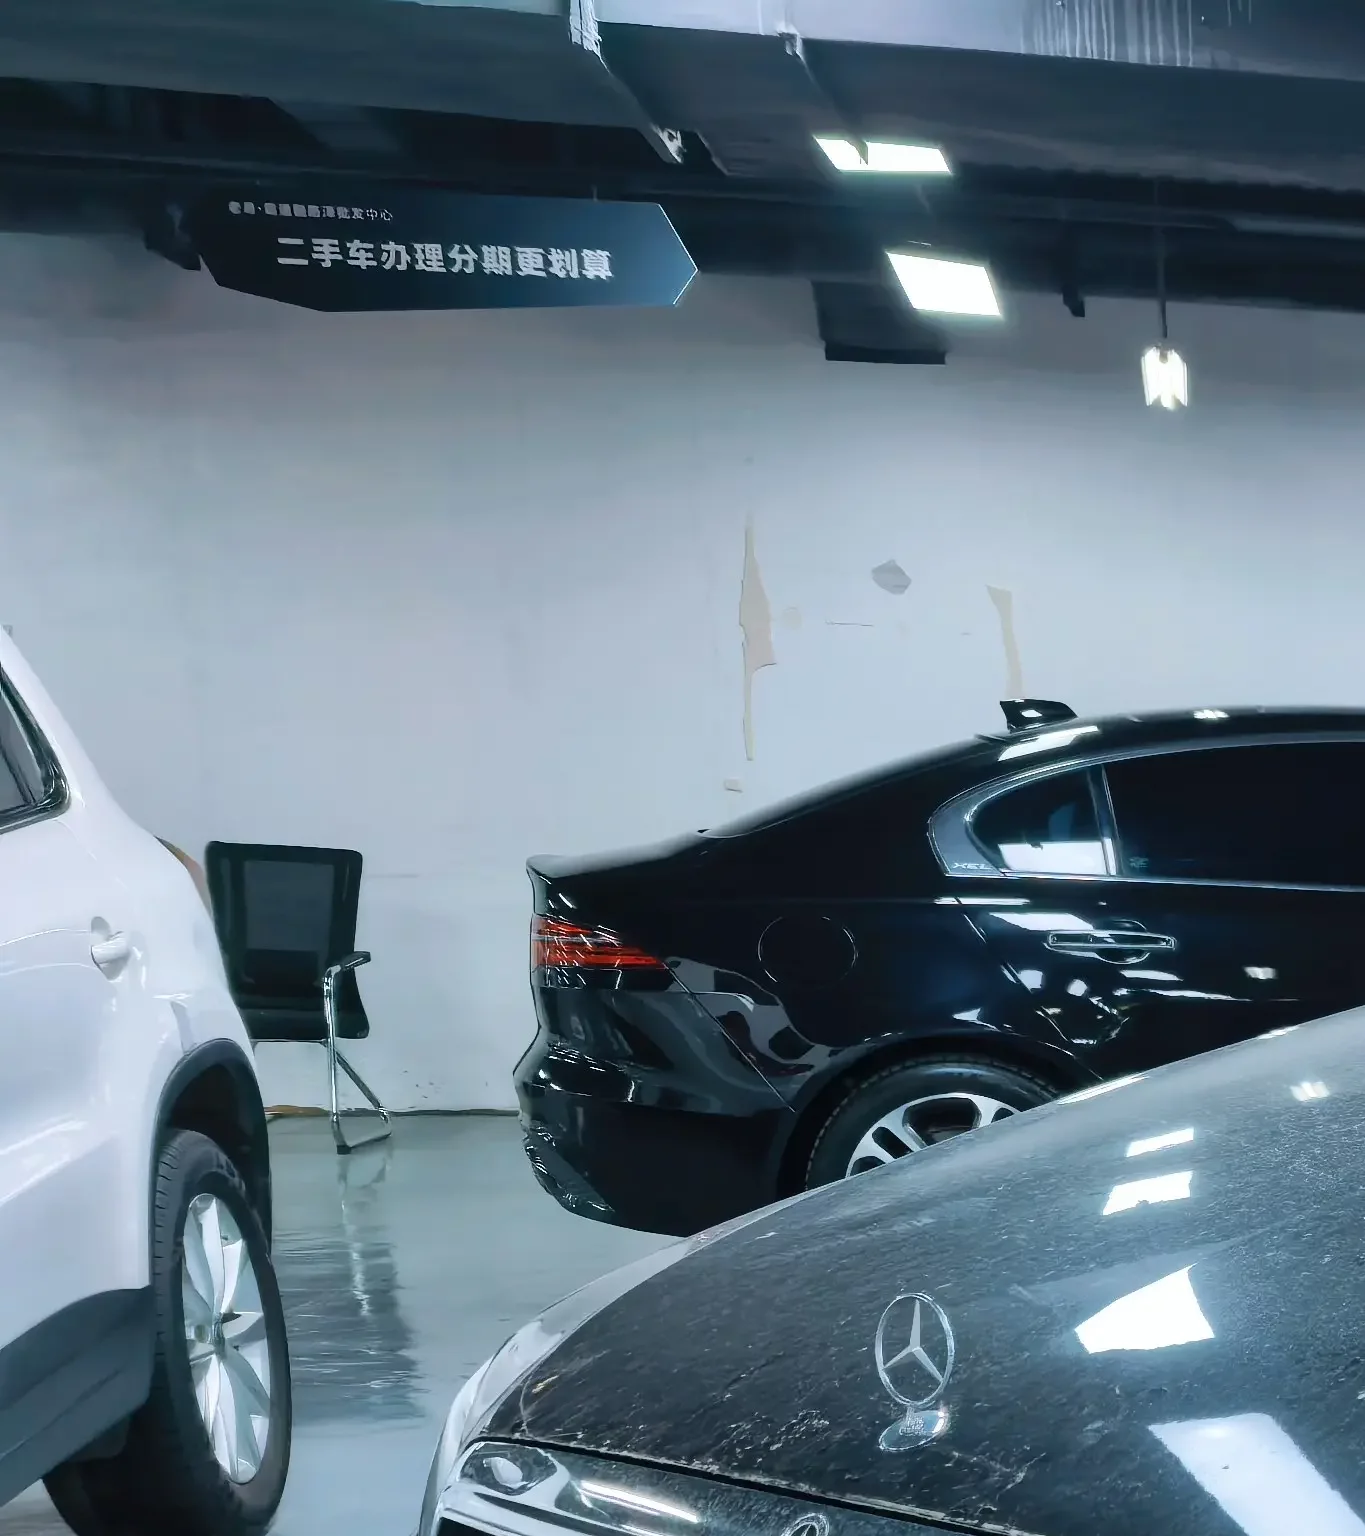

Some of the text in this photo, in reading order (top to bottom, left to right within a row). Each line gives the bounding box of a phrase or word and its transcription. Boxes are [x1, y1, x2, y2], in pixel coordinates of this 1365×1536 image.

[278, 237, 613, 281] 二手车办理分期更划算
